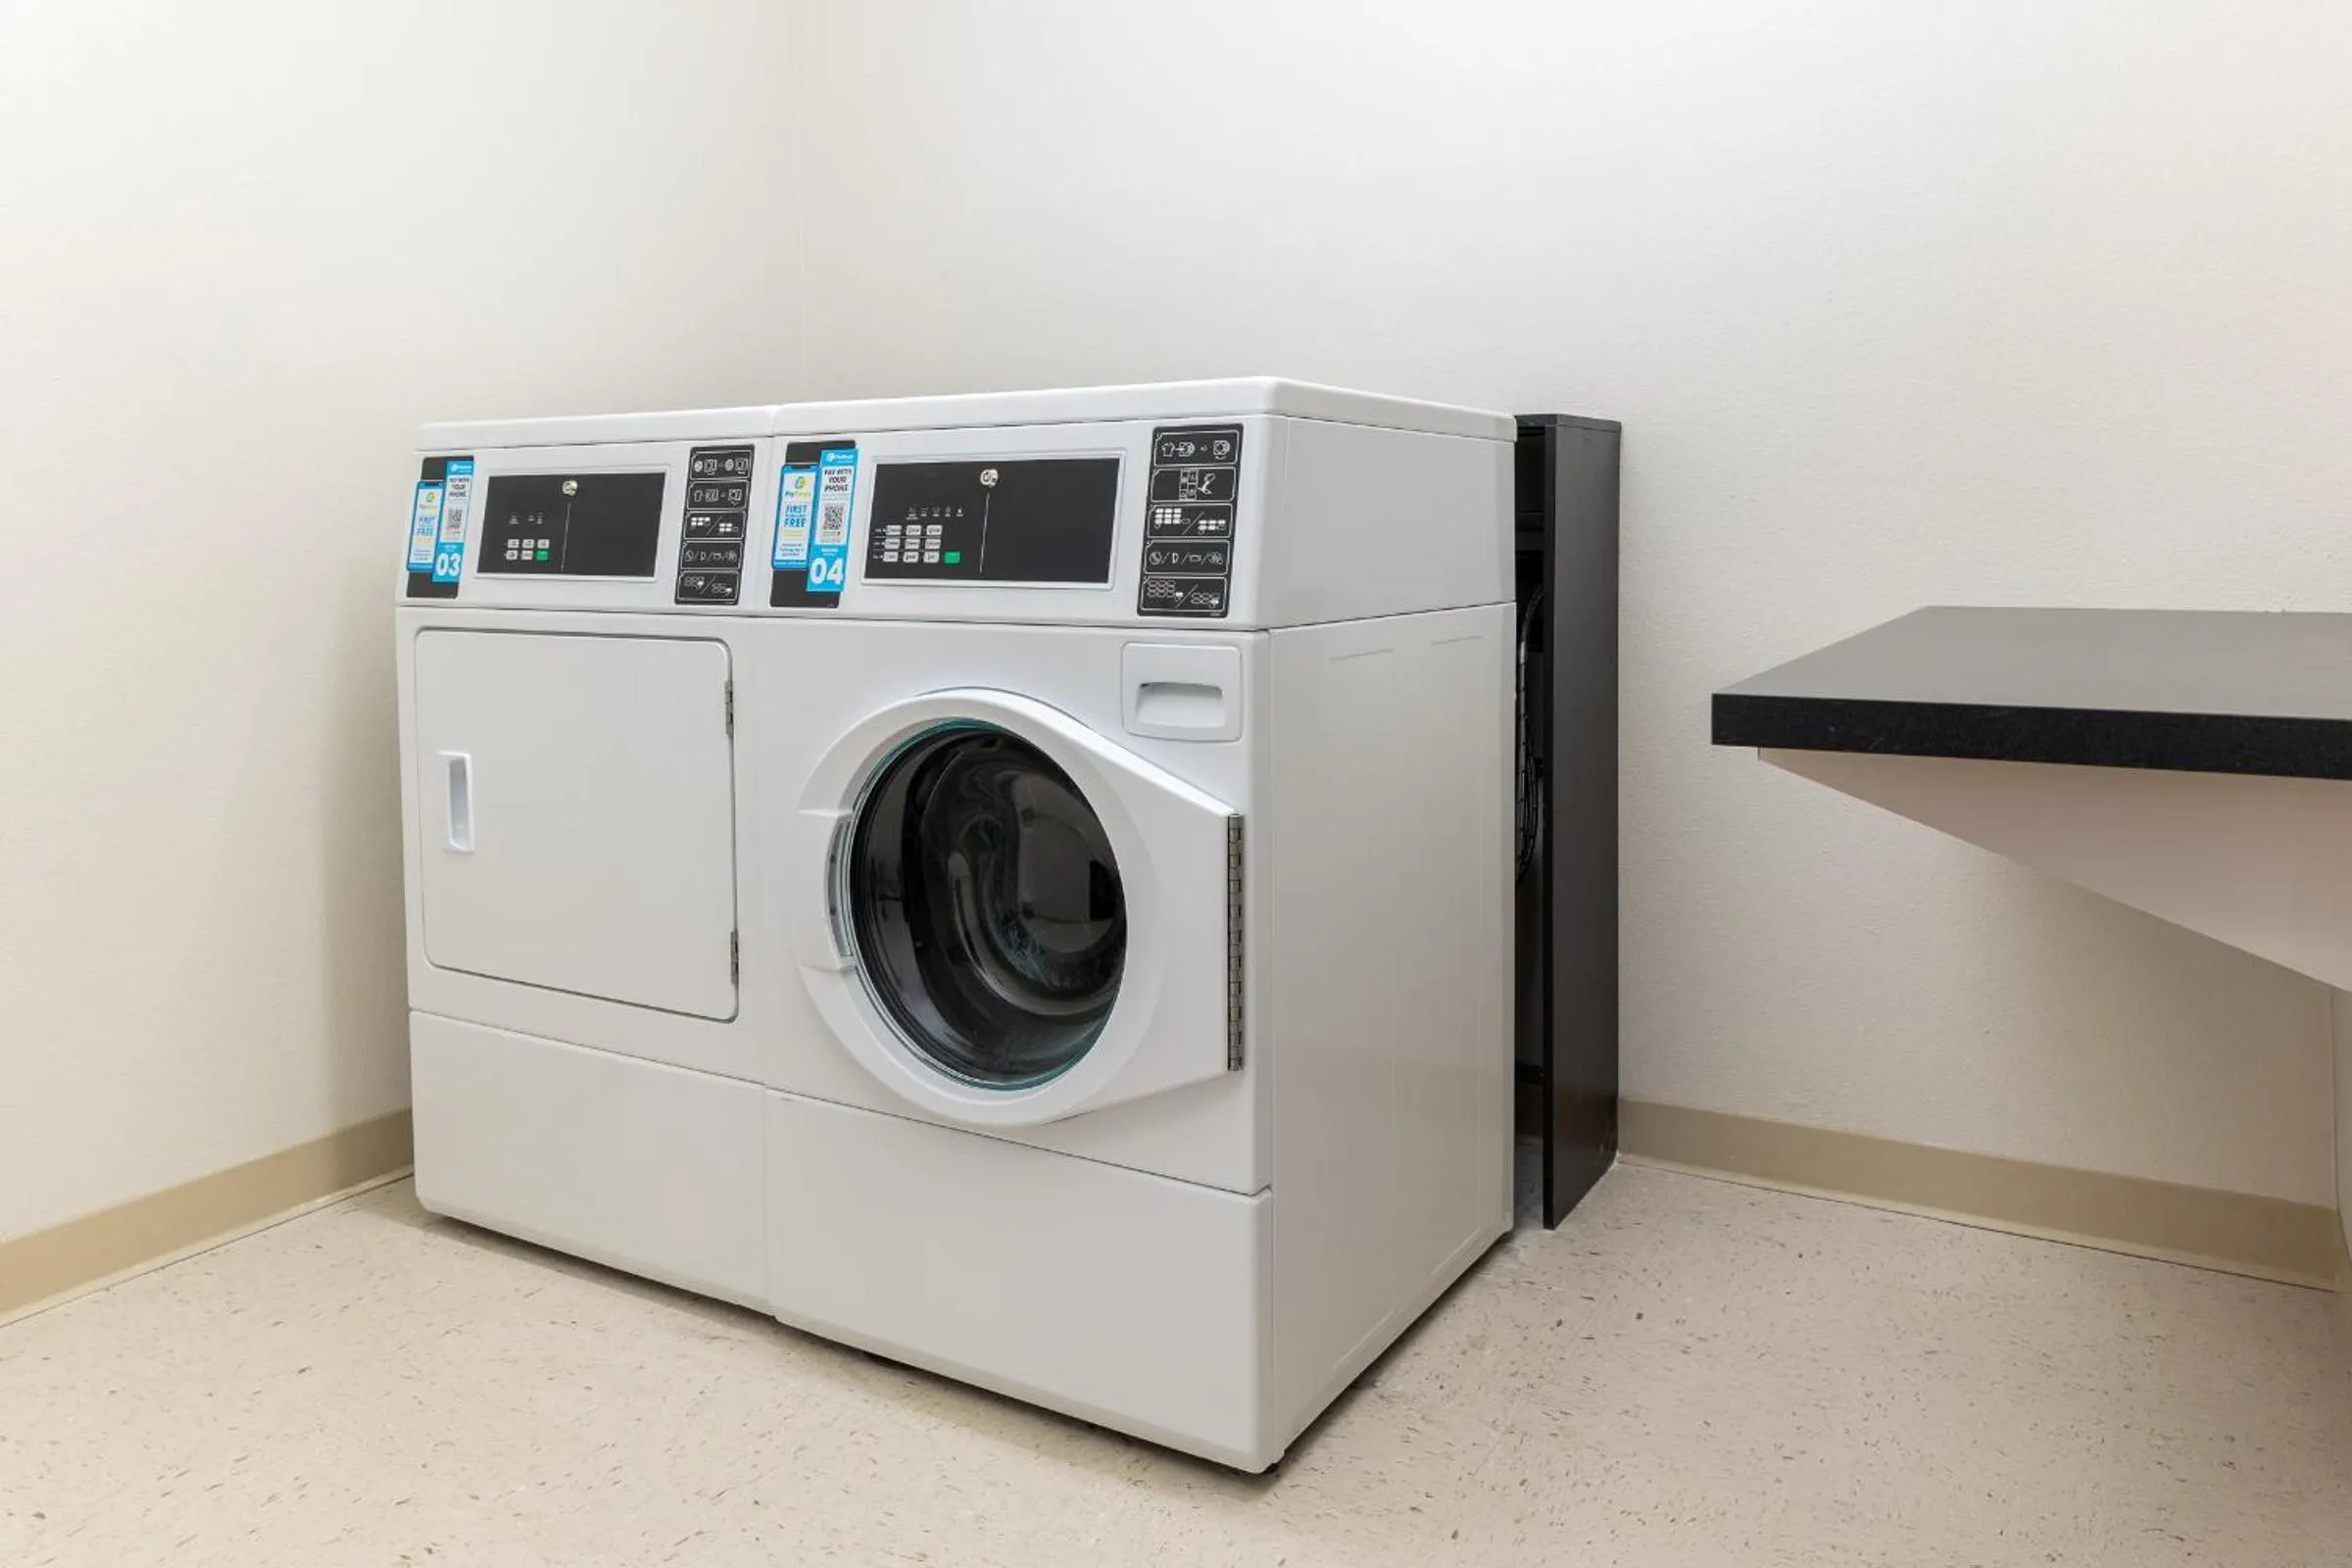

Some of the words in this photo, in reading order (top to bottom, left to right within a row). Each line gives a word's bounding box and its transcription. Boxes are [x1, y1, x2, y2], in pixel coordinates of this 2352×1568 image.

[824, 484, 849, 493] PHONE
[785, 504, 808, 514] FIRST
[784, 517, 807, 528] FREE
[436, 552, 461, 576] 03
[809, 557, 843, 585] 04
